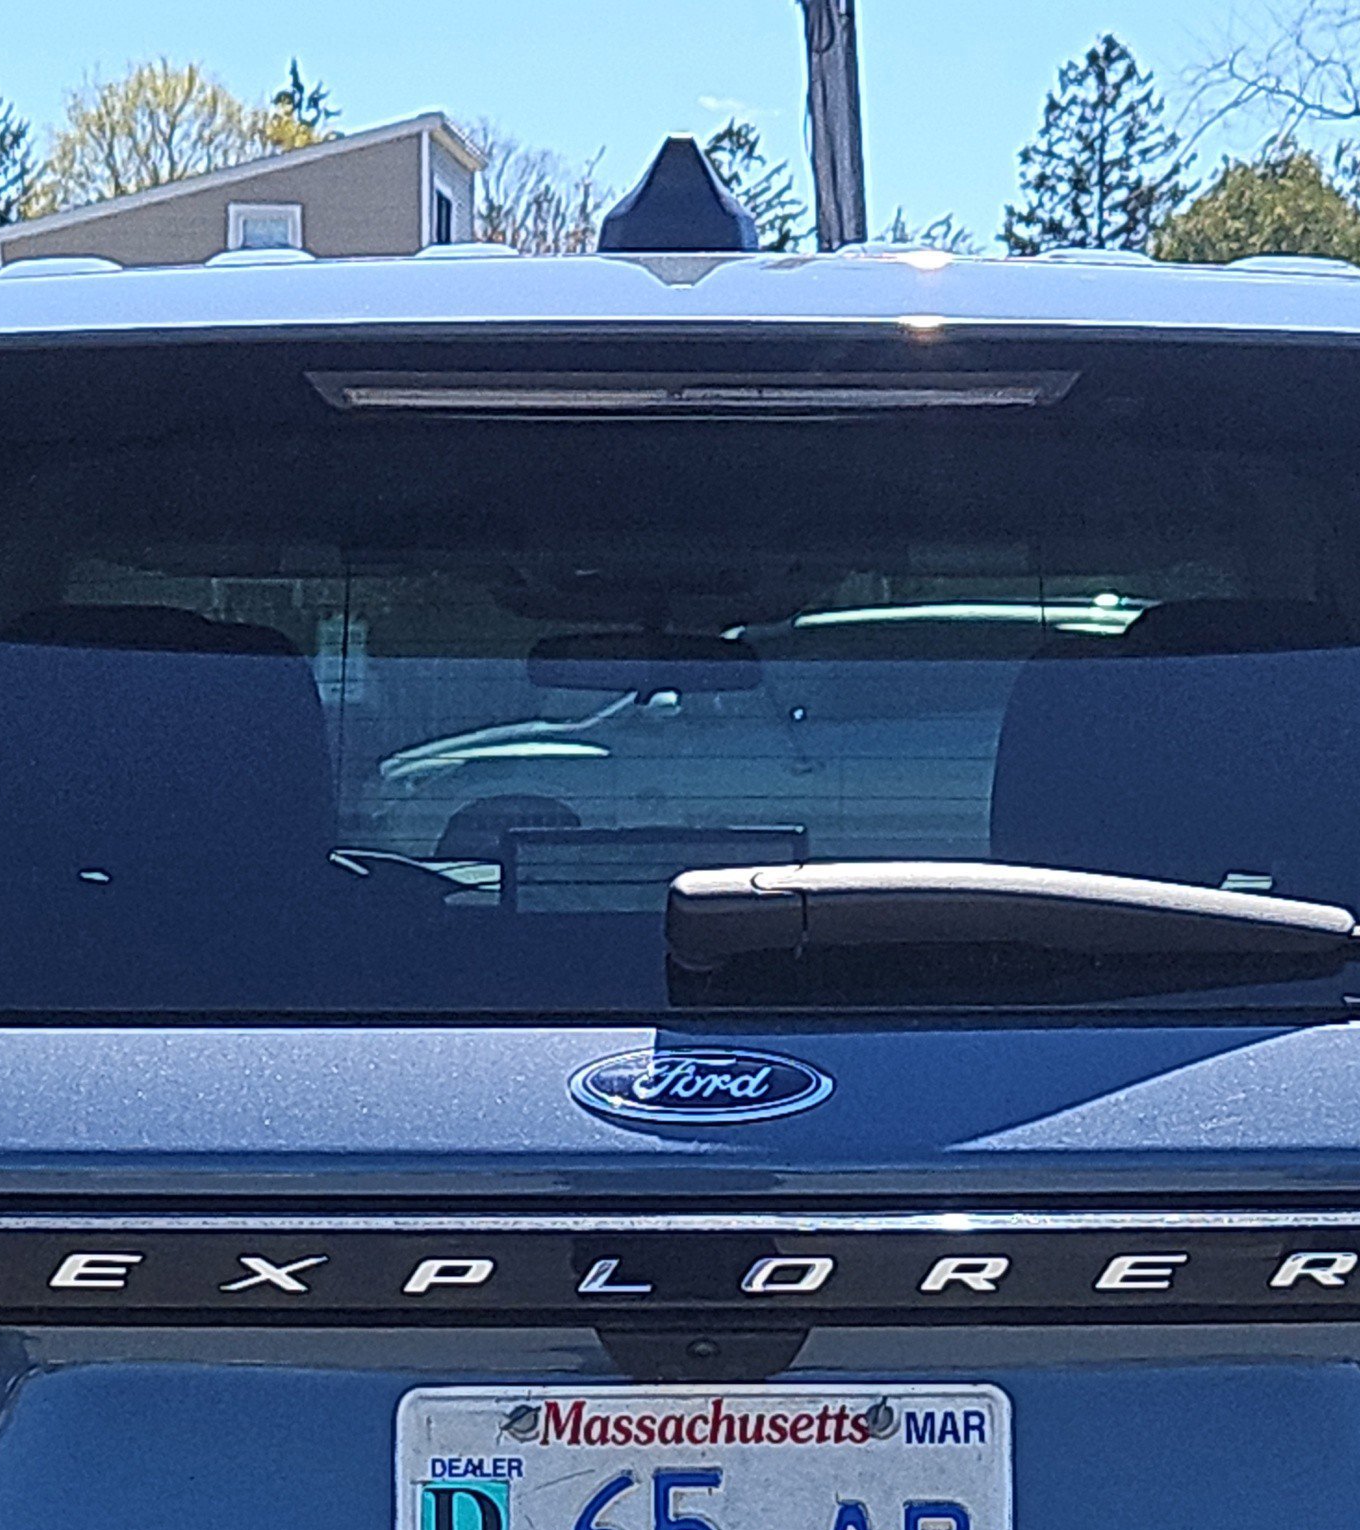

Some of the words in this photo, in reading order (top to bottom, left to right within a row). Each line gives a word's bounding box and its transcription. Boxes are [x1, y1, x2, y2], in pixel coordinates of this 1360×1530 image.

[632, 1057, 774, 1099] Ford
[49, 1252, 1360, 1294] EXPLORER
[539, 1399, 872, 1447] Massachusetts
[904, 1409, 987, 1445] MAR
[430, 1458, 525, 1479] DEALER
